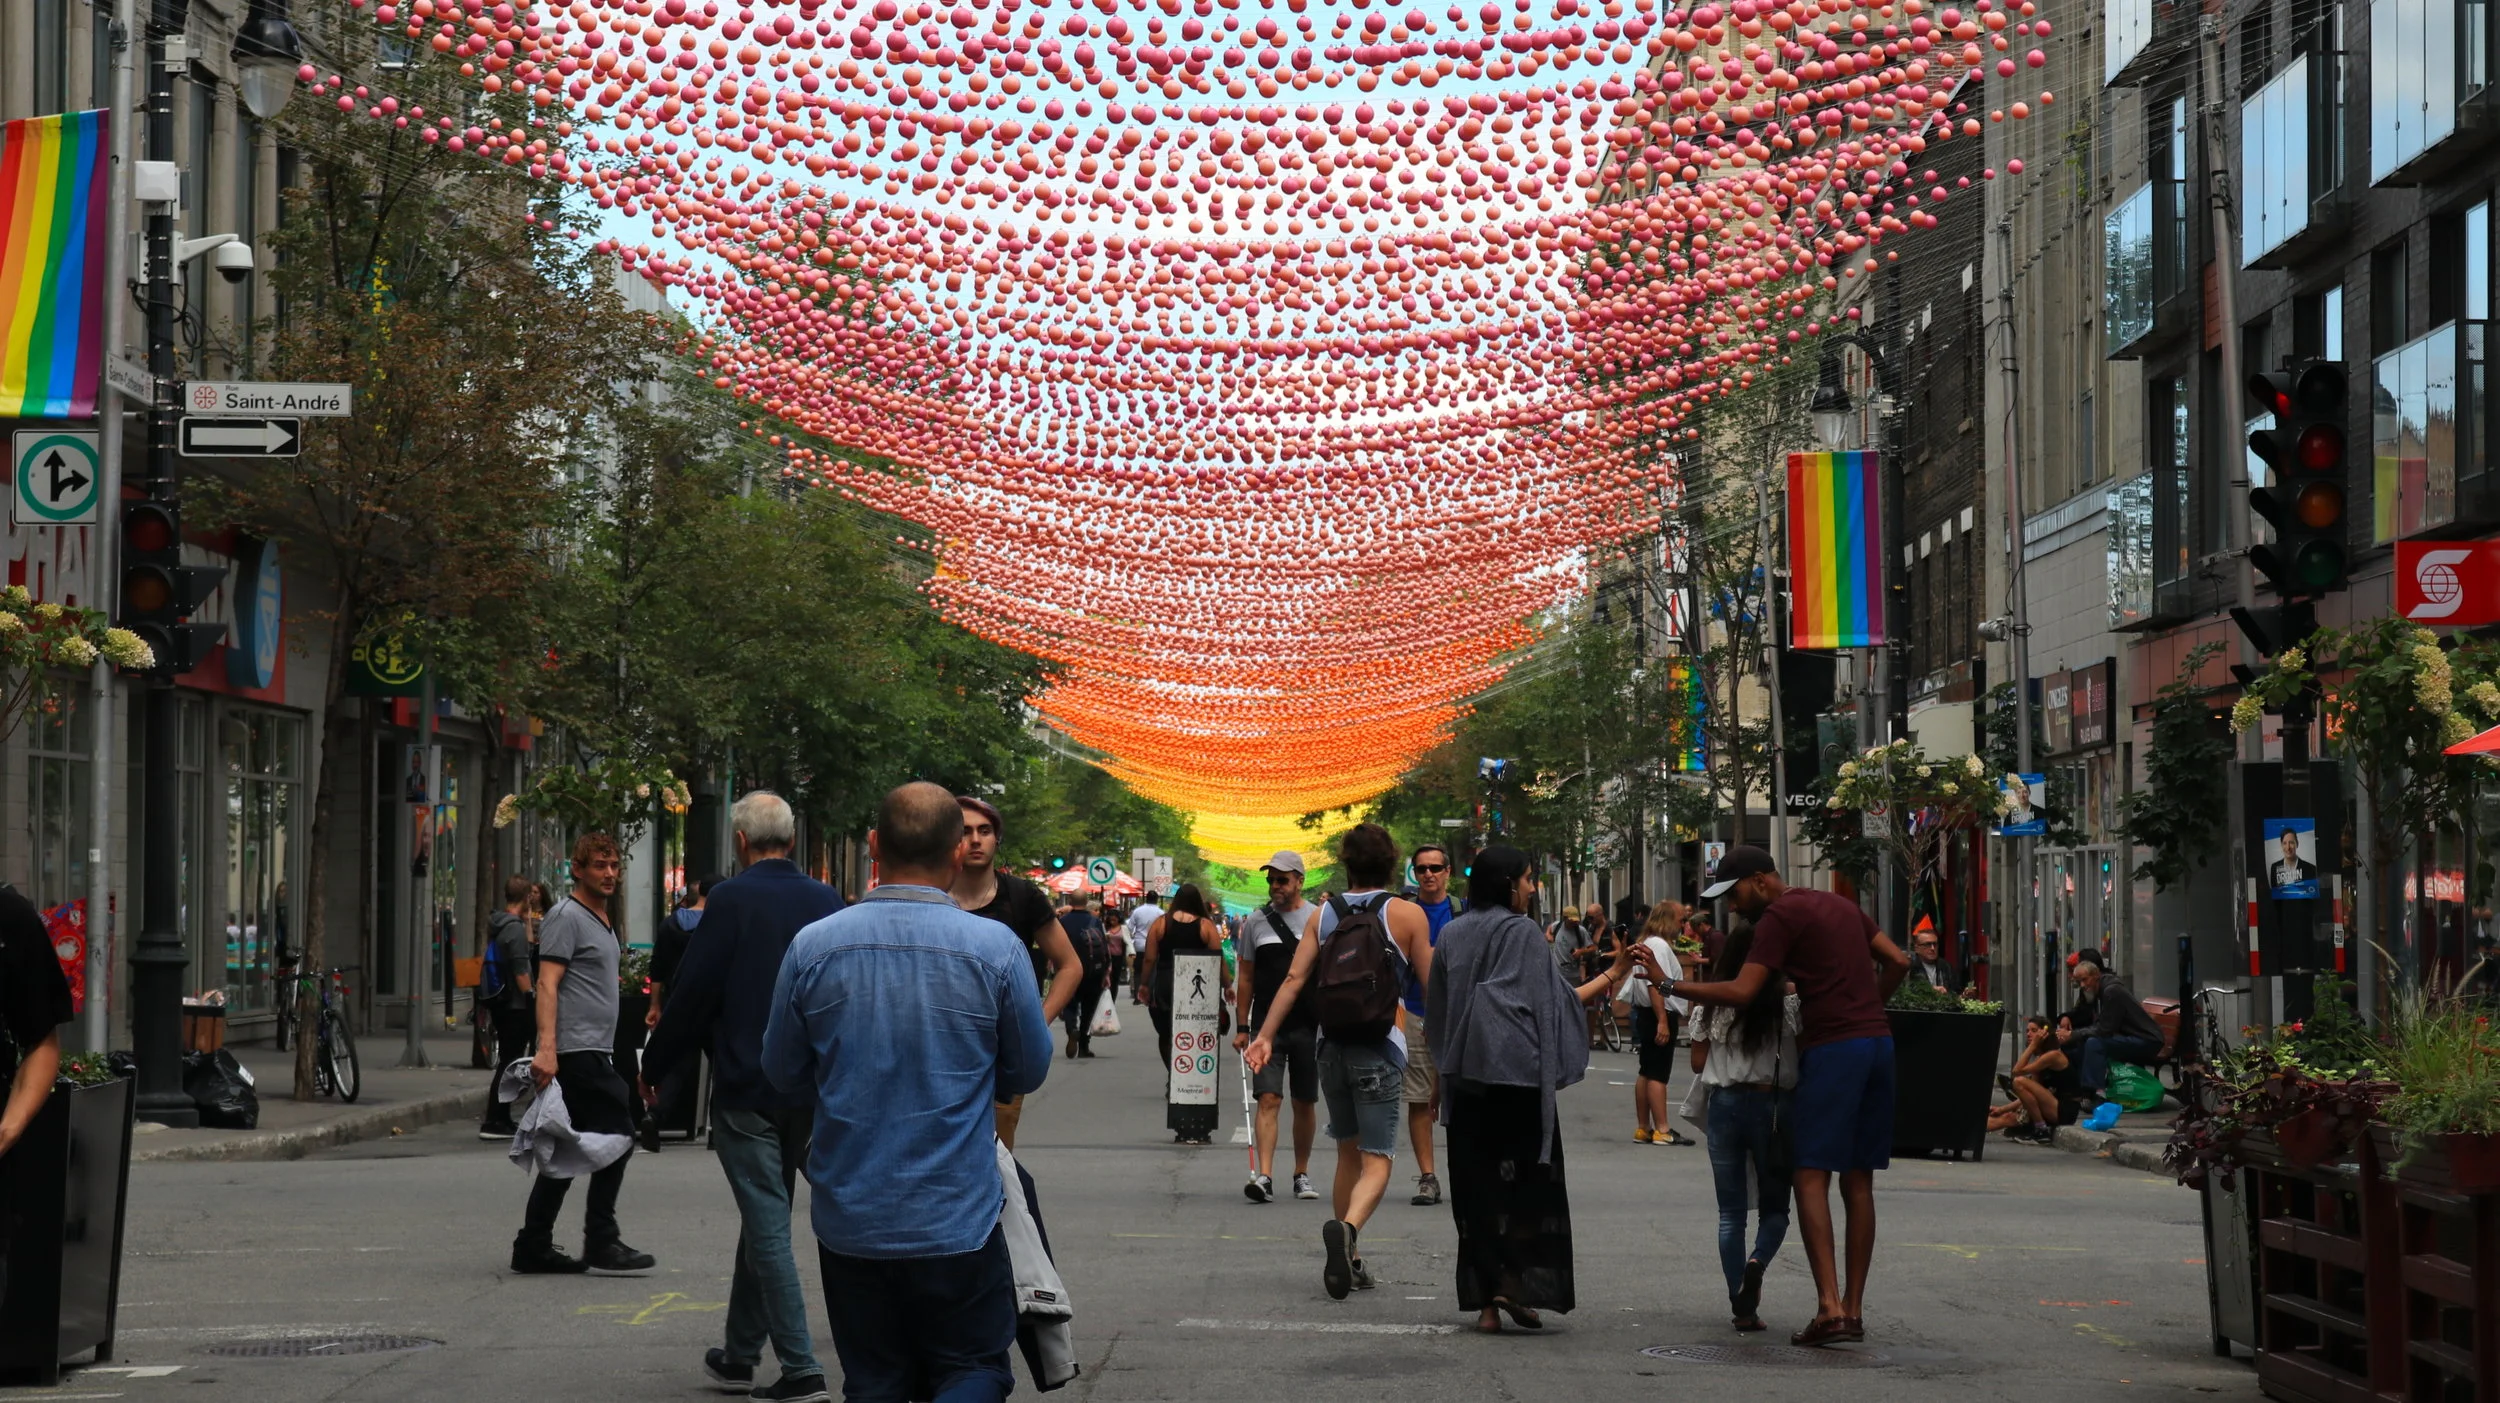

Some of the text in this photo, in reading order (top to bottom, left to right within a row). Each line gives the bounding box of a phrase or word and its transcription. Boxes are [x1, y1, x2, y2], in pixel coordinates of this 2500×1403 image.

[225, 393, 341, 411] Saint-André
[2276, 868, 2302, 884] DROUIN
[1175, 1013, 1190, 1021] ZONE
